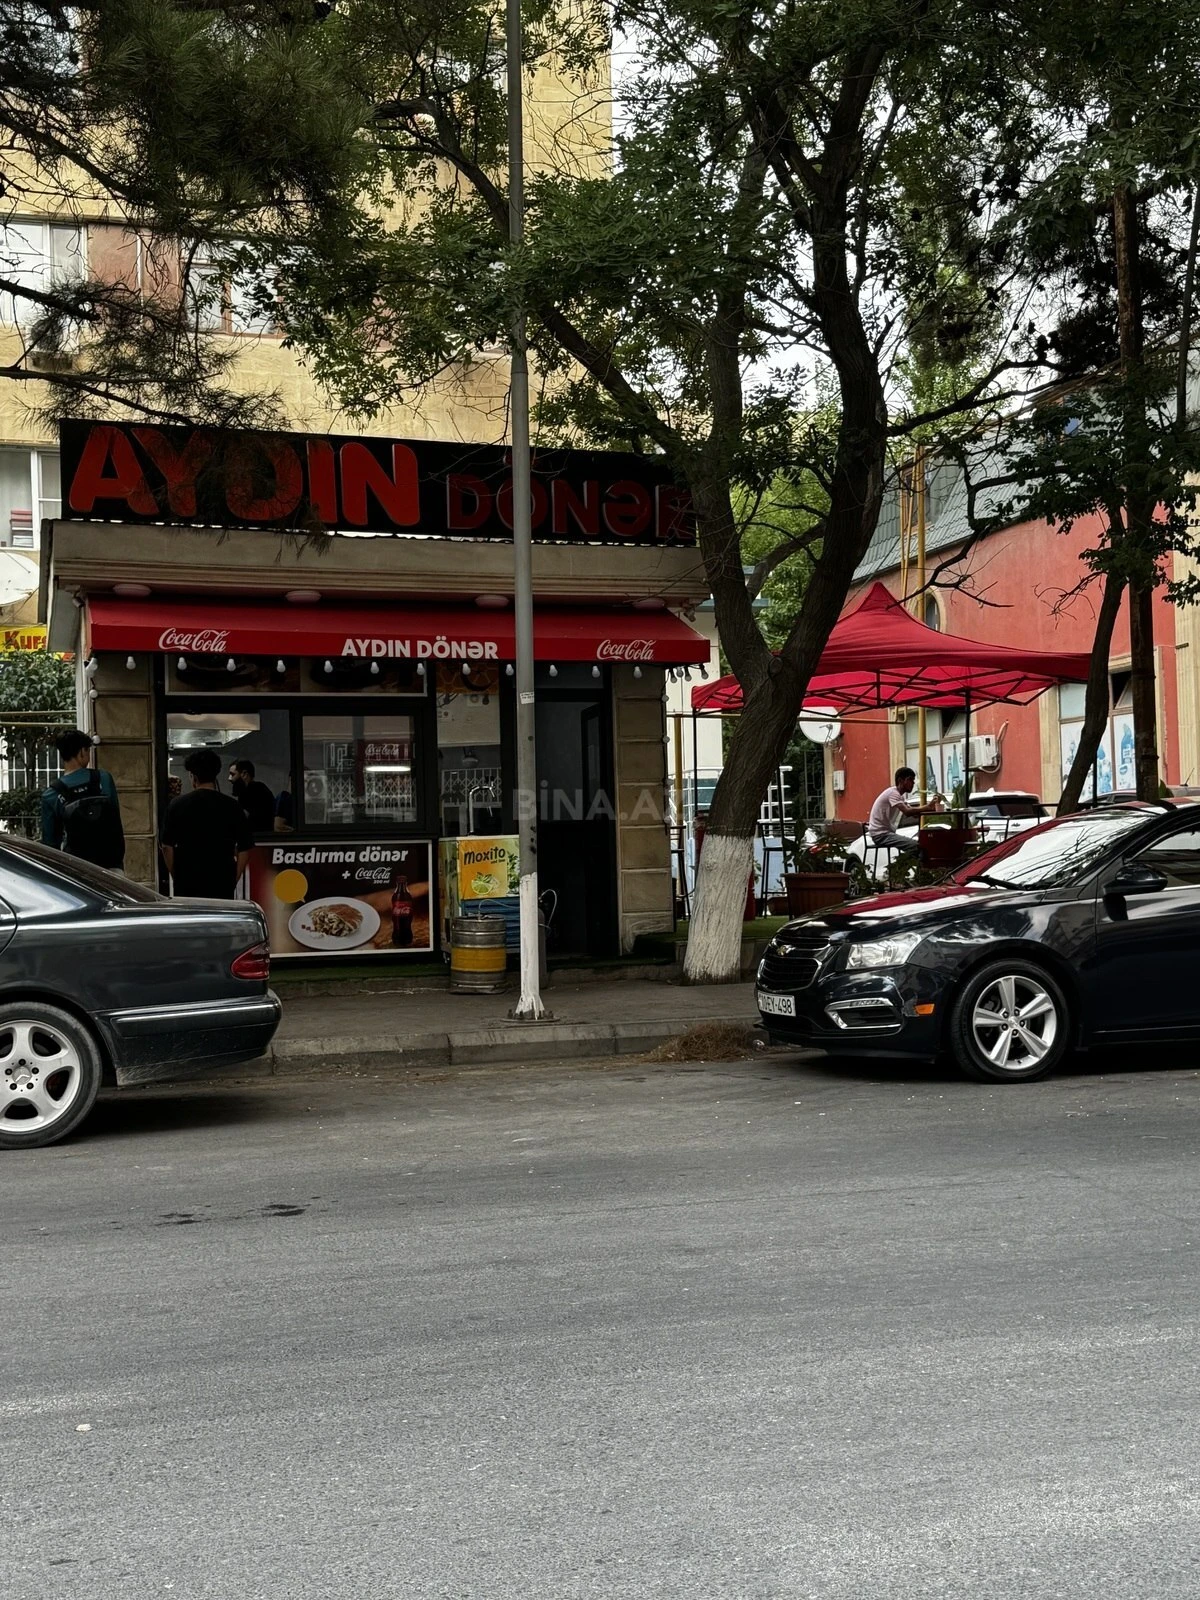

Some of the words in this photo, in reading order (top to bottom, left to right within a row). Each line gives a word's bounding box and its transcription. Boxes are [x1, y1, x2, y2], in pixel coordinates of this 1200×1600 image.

[68, 425, 421, 527] AYDIN
[158, 627, 230, 652] Coca-Cola
[341, 638, 411, 658] AYDIN
[417, 635, 499, 660] DÖNƏR
[596, 639, 656, 661] Coca-Cola
[272, 847, 355, 864] Basdırma
[358, 846, 408, 862] dönər
[355, 866, 392, 881] Coca-Cola
